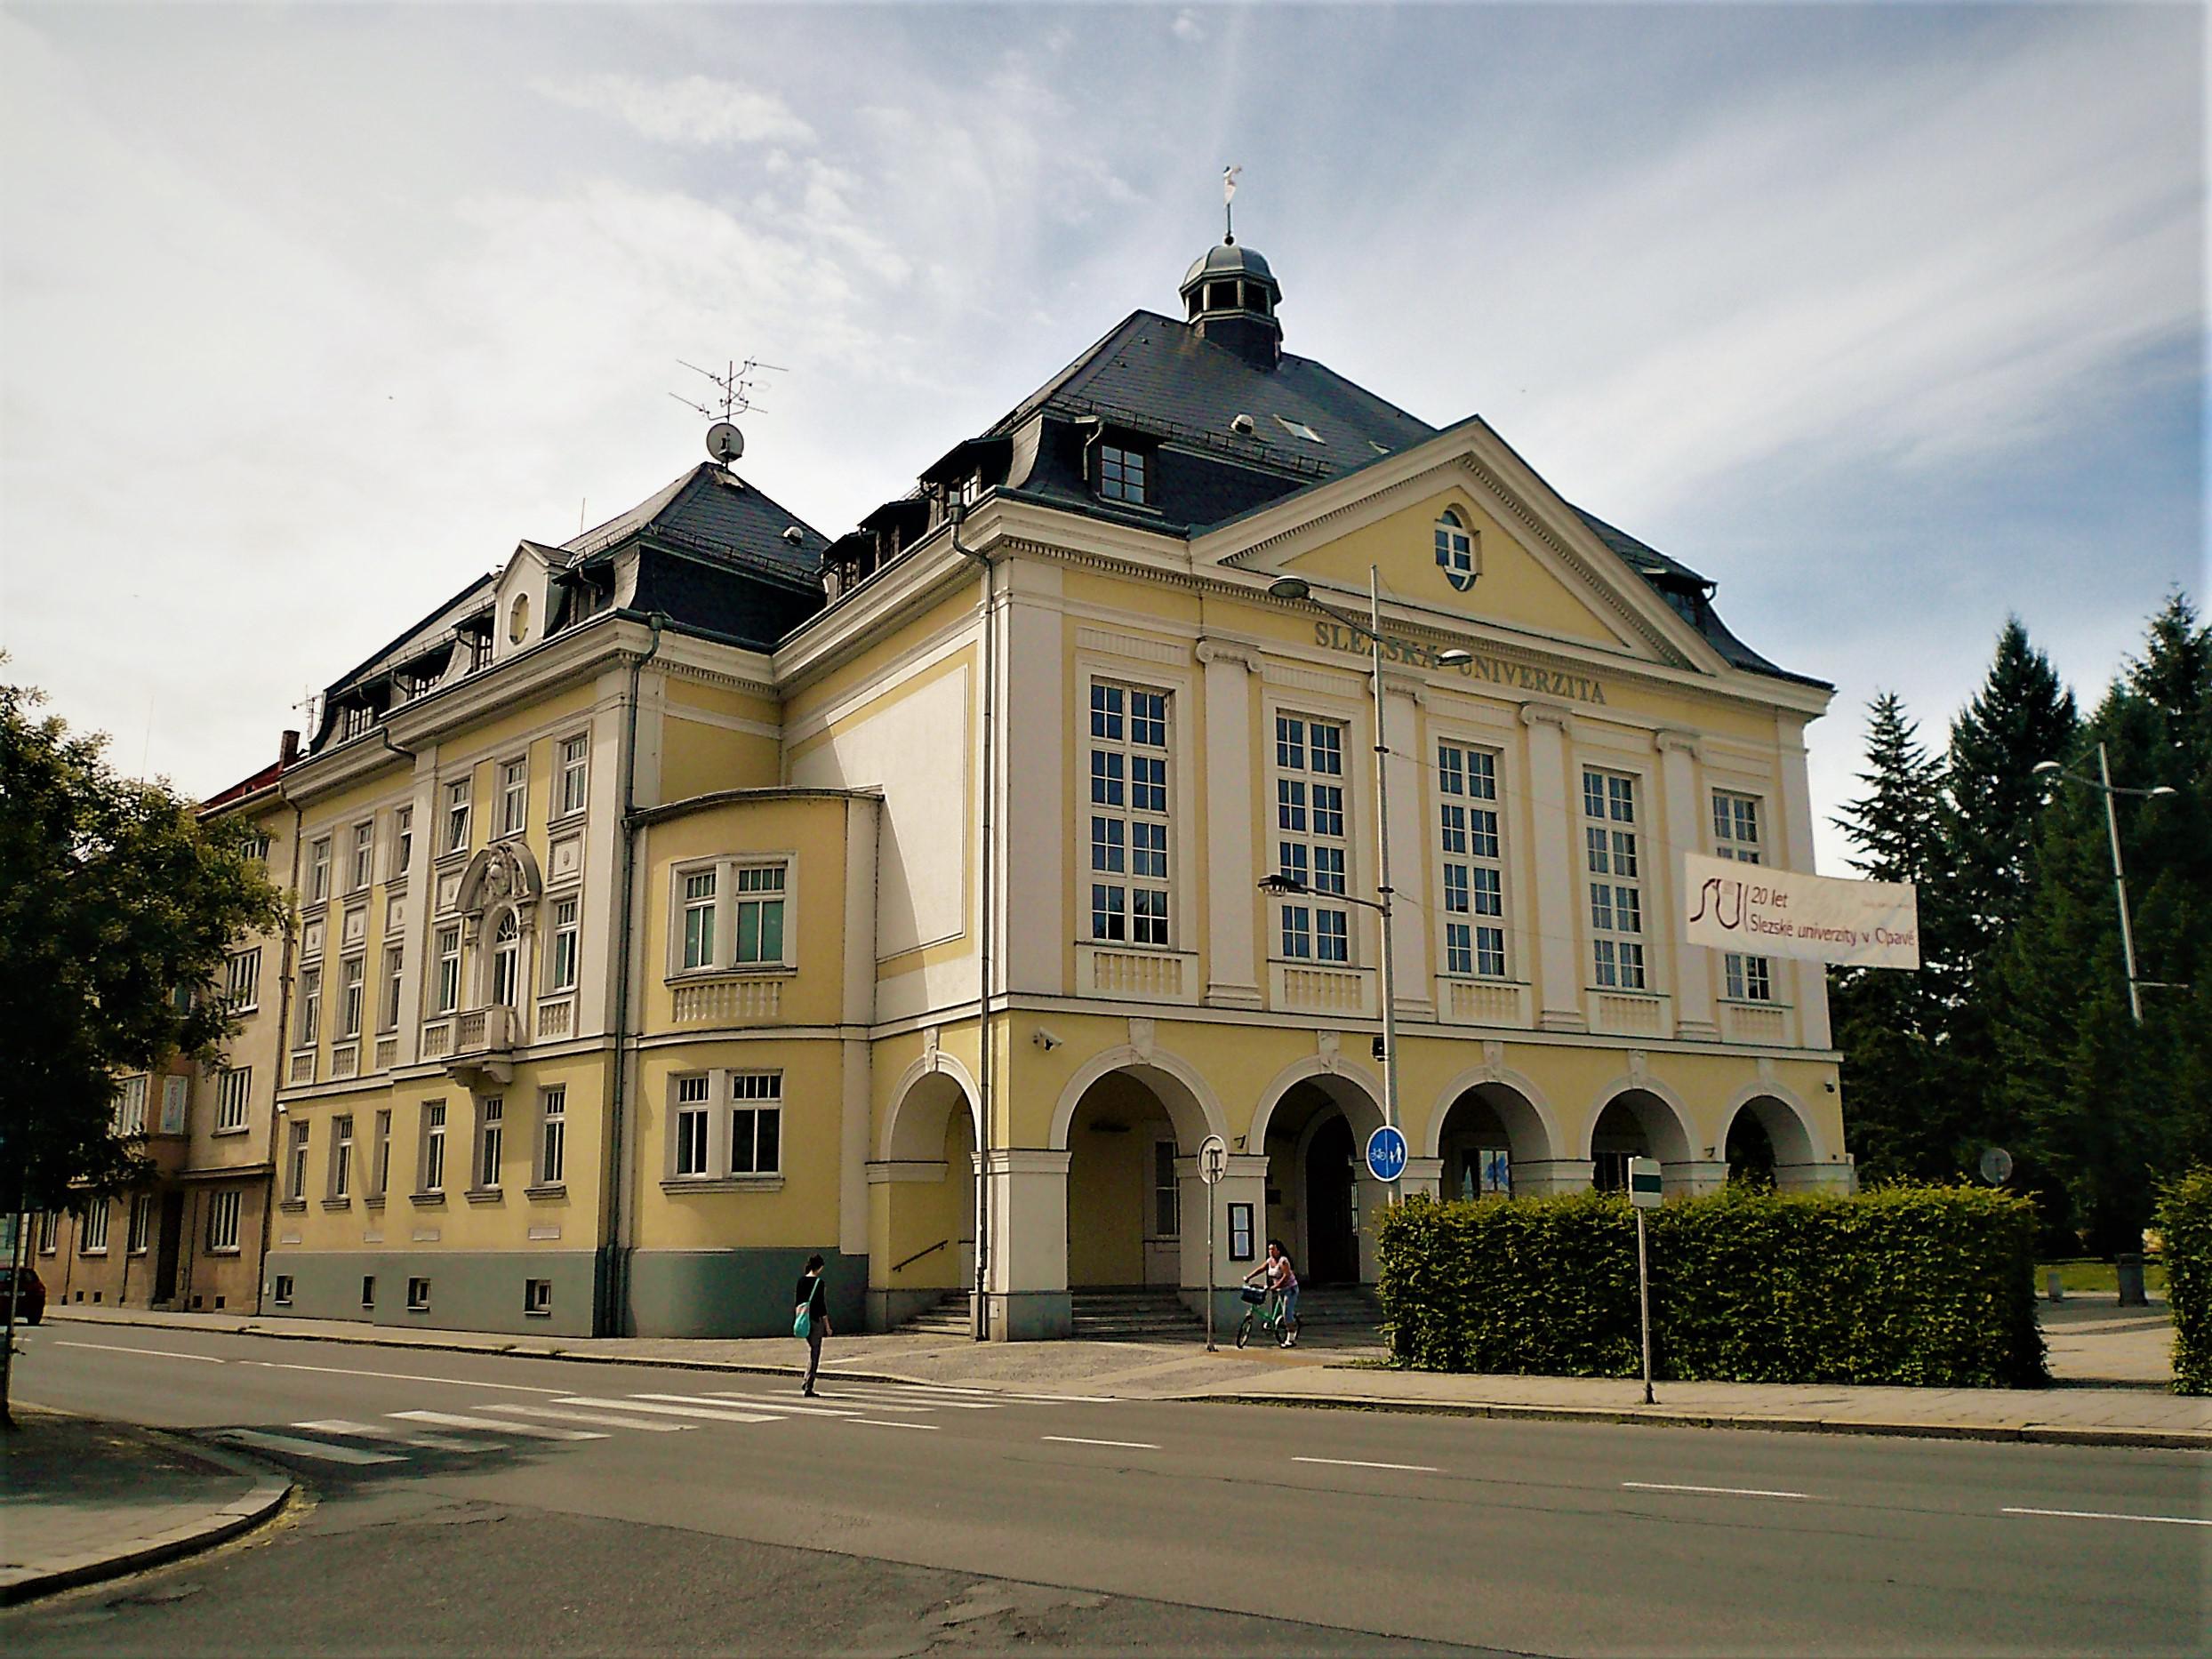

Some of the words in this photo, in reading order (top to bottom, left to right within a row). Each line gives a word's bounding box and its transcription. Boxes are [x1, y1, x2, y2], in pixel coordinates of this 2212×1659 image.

[1751, 886, 1767, 905] 20
[1772, 889, 1788, 909] let
[1750, 913, 1793, 937] Slezské
[1798, 923, 1857, 947] univerzity
[1862, 932, 1871, 943] v
